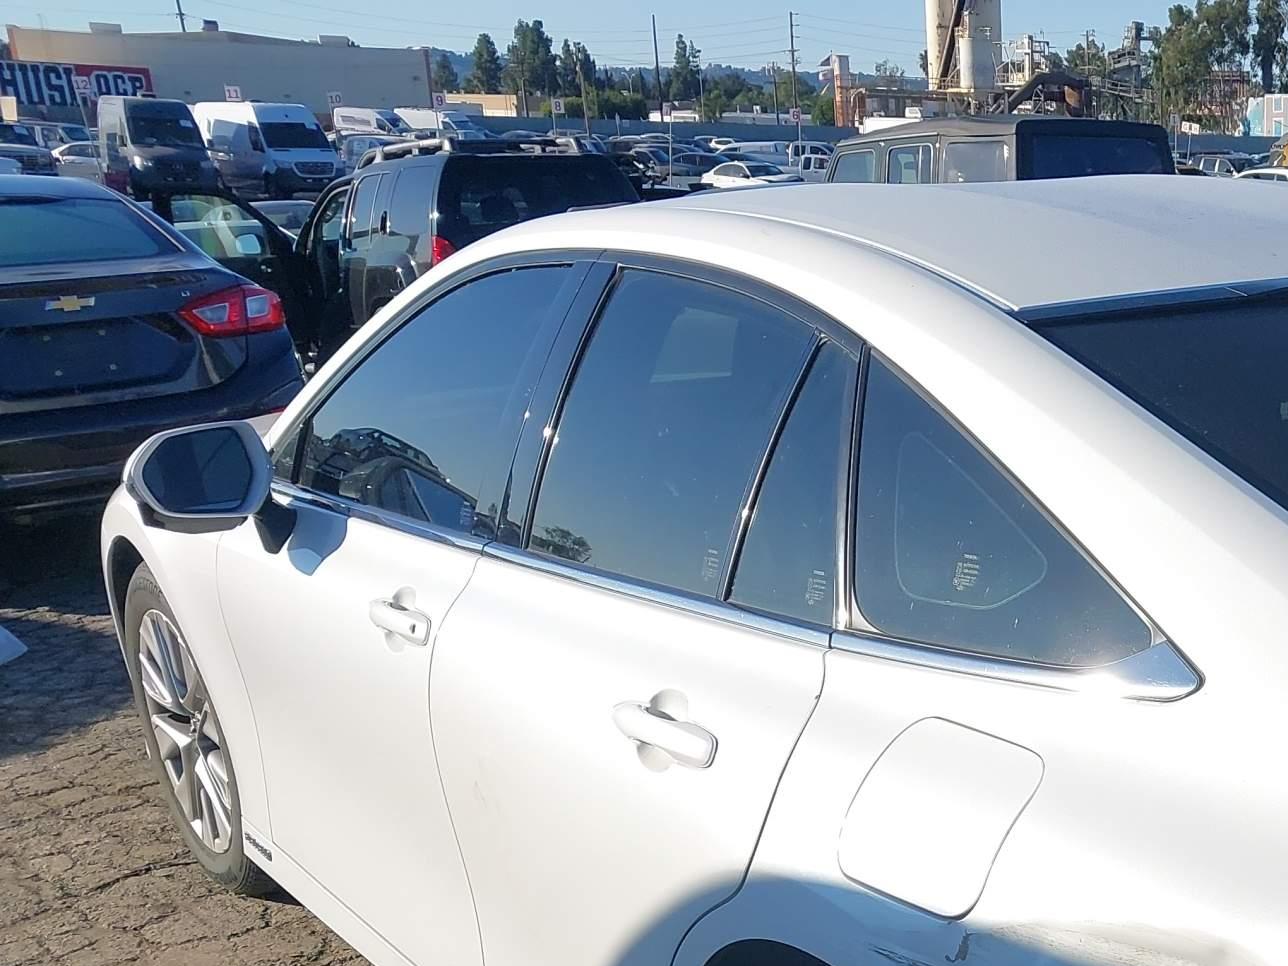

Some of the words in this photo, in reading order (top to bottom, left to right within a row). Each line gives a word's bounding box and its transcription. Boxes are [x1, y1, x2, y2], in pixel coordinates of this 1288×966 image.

[74, 79, 89, 90] 12
[226, 88, 241, 99] 11
[328, 94, 342, 104] 10
[435, 95, 444, 106] 9
[553, 100, 561, 112] 8
